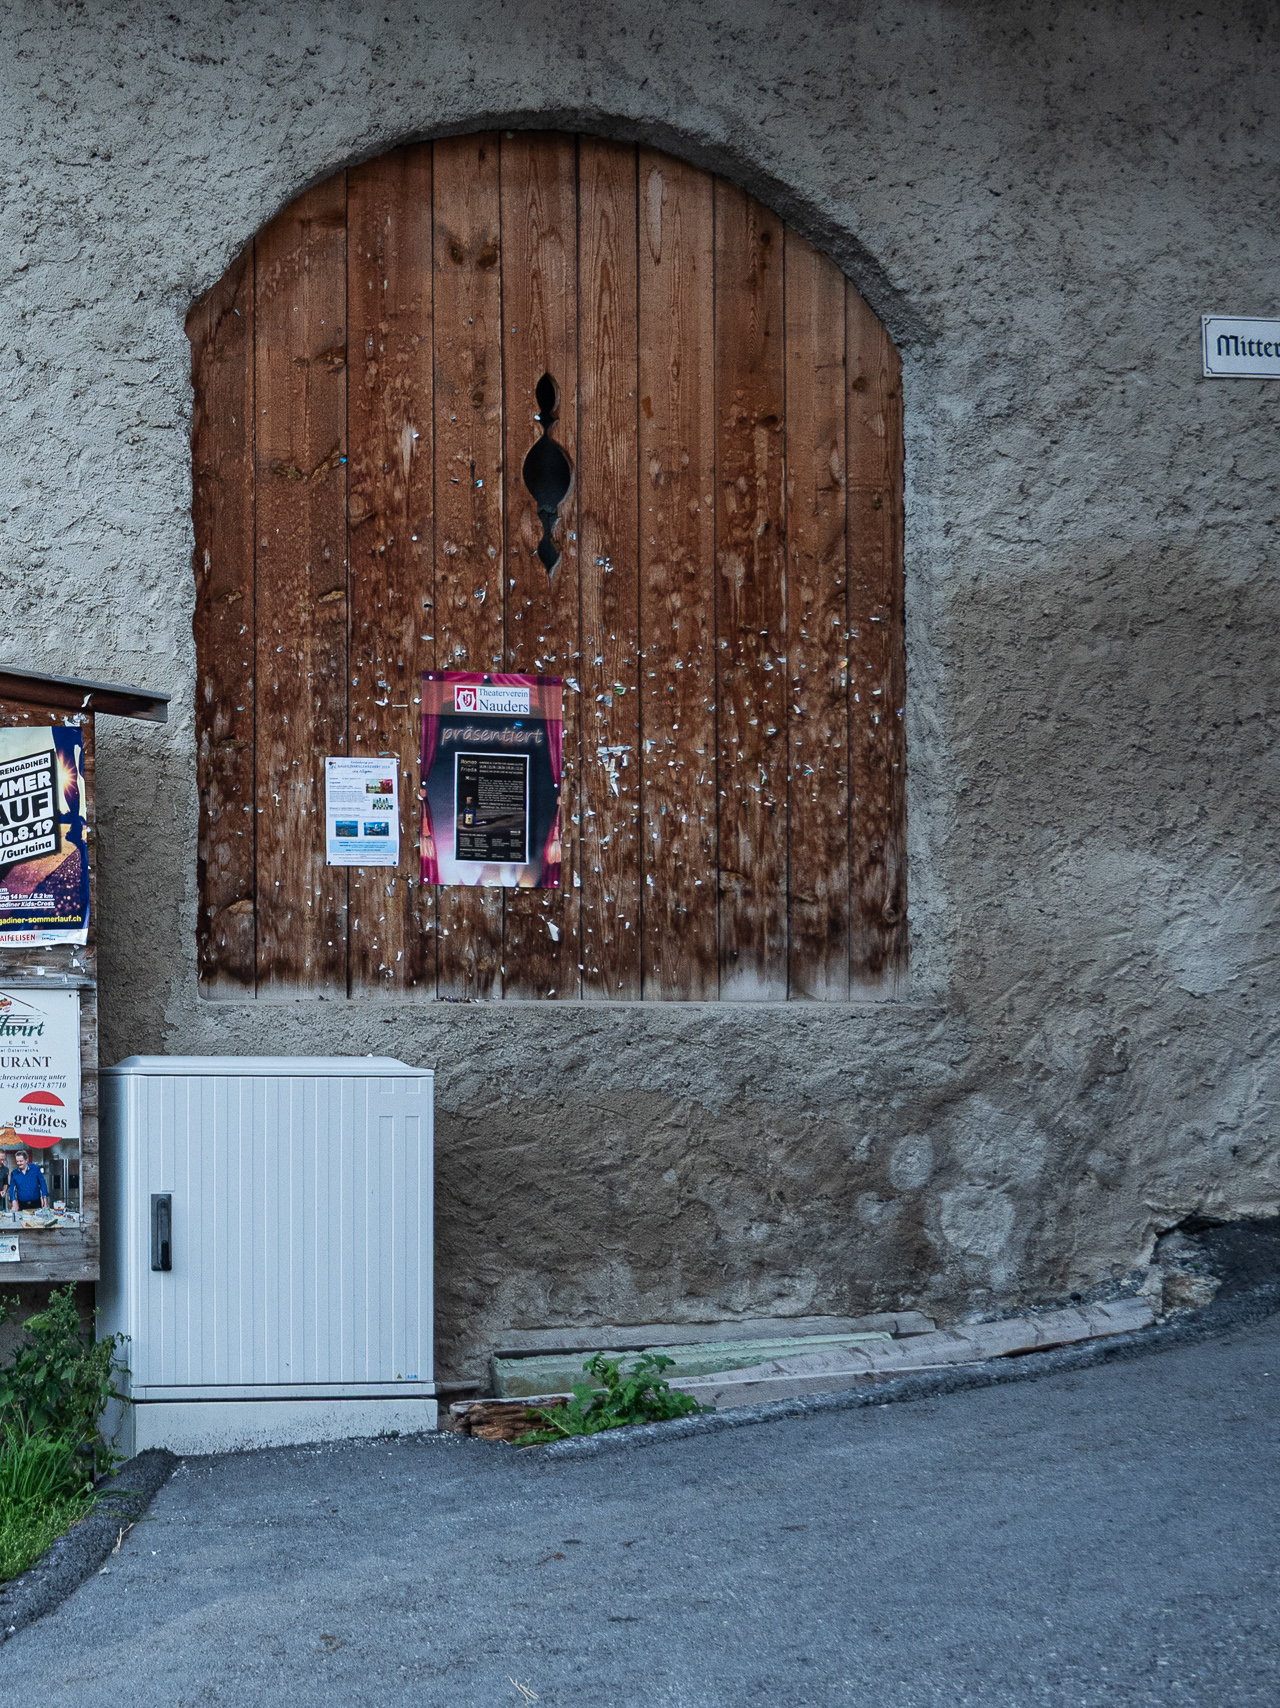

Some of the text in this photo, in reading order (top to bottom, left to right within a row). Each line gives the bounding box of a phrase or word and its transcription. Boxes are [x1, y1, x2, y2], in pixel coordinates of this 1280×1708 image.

[478, 688, 528, 698] Theaterverein
[479, 699, 529, 713] Nauders
[441, 726, 543, 746] präsentiert
[27, 1105, 56, 1113] Österreichs
[14, 1113, 67, 1128] größtes
